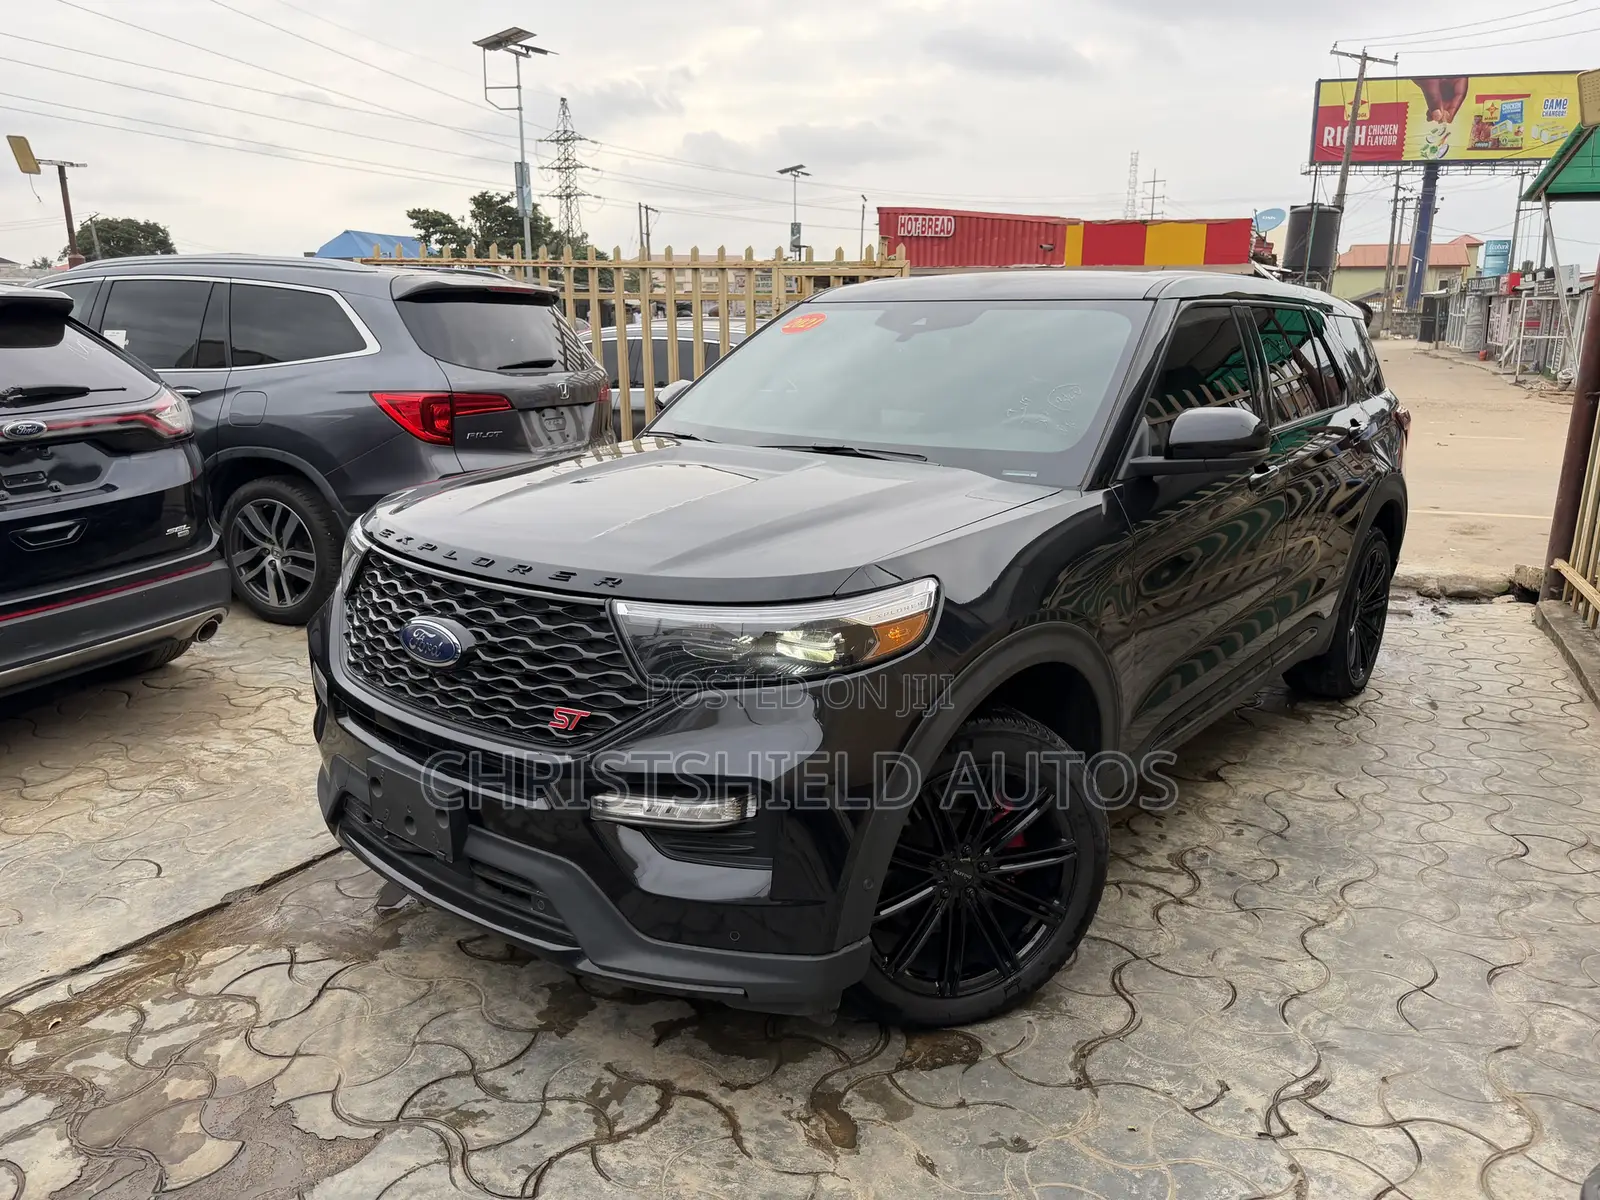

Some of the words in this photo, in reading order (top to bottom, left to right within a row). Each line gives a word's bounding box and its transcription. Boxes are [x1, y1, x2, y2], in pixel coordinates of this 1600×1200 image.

[1543, 98, 1568, 110] GAME
[1368, 124, 1398, 136] CHICKEN
[1367, 135, 1398, 146] FLAVOUR
[920, 217, 954, 236] BREAD
[16, 424, 39, 434] Ford
[466, 430, 503, 440] PILOT
[378, 528, 624, 588] EXPLORER
[409, 628, 448, 657] Ford
[548, 707, 591, 731] ST
